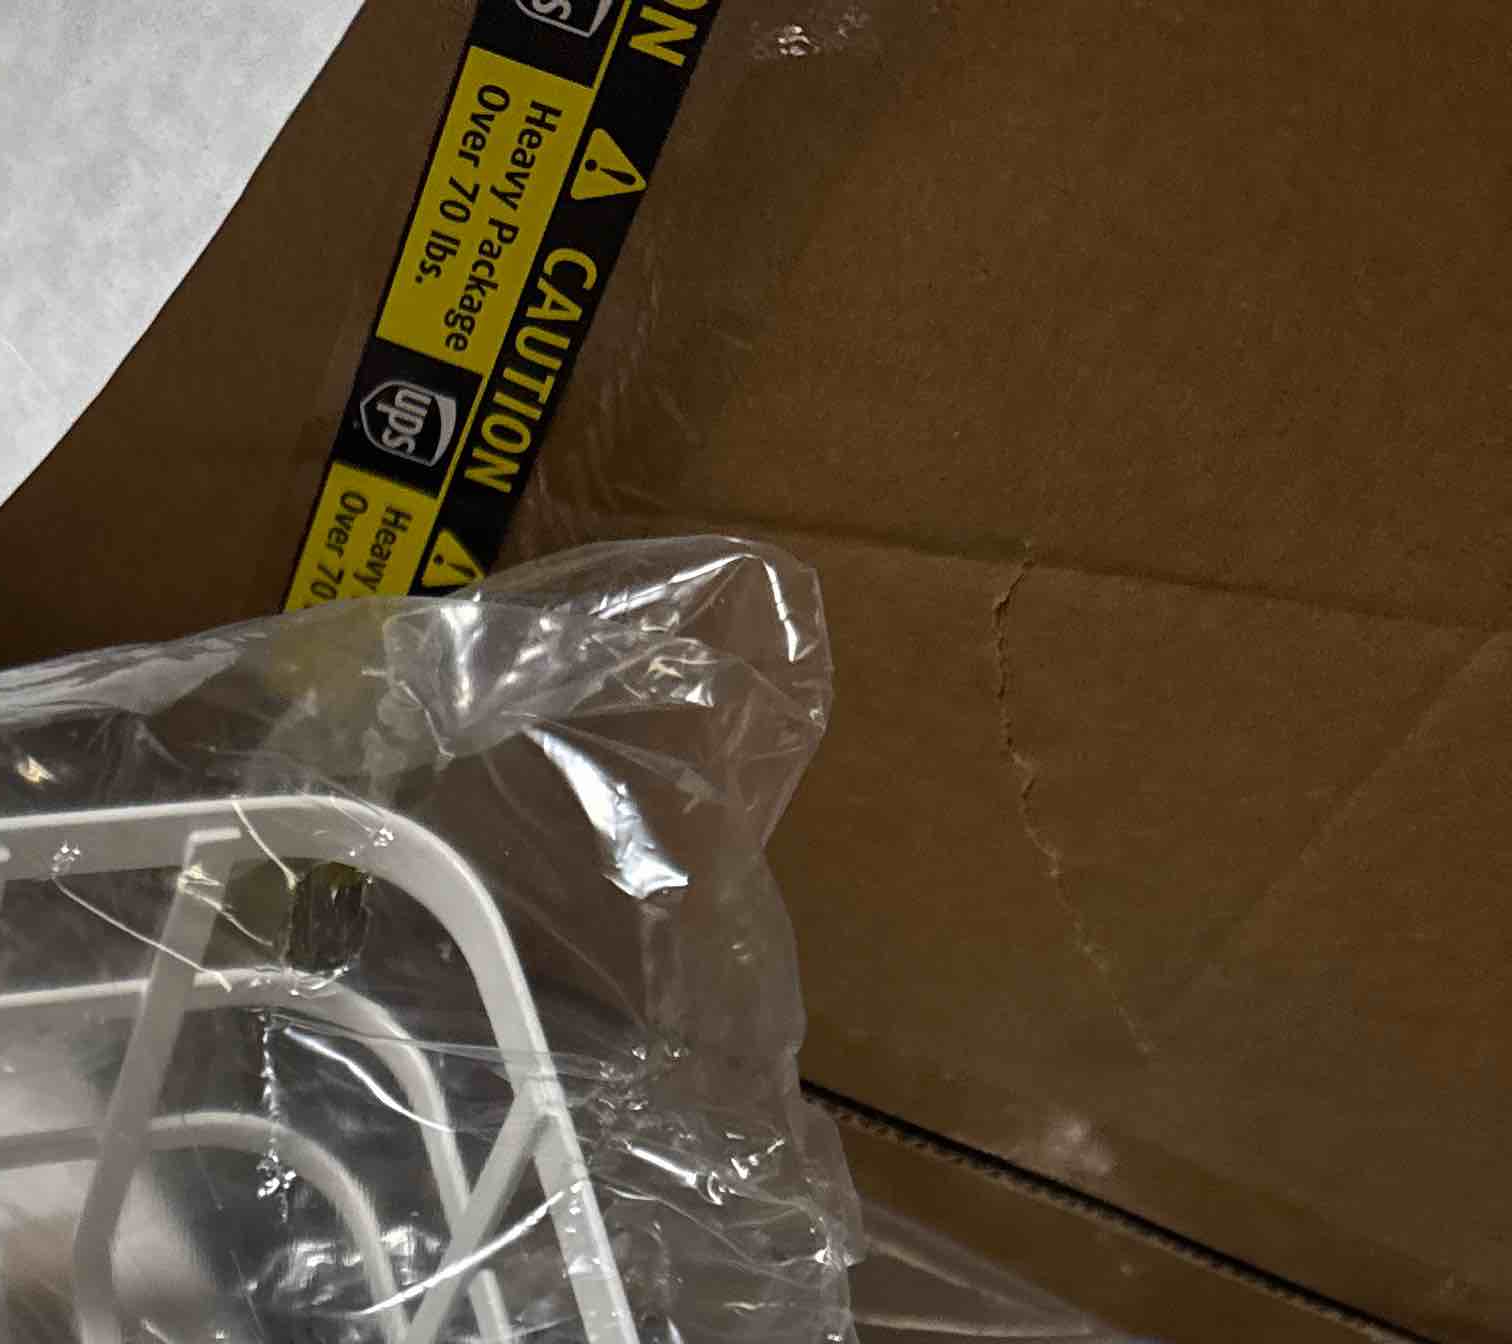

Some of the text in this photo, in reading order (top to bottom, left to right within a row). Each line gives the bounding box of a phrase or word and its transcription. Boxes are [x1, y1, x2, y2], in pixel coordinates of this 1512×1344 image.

[415, 84, 510, 285] Over 70 lbs.
[489, 100, 563, 210] Heavy
[444, 217, 520, 353] Package
[377, 388, 434, 456] ups
[464, 248, 597, 493] CAUTION
[310, 491, 369, 600] Over 70
[353, 505, 413, 592] Heavy
